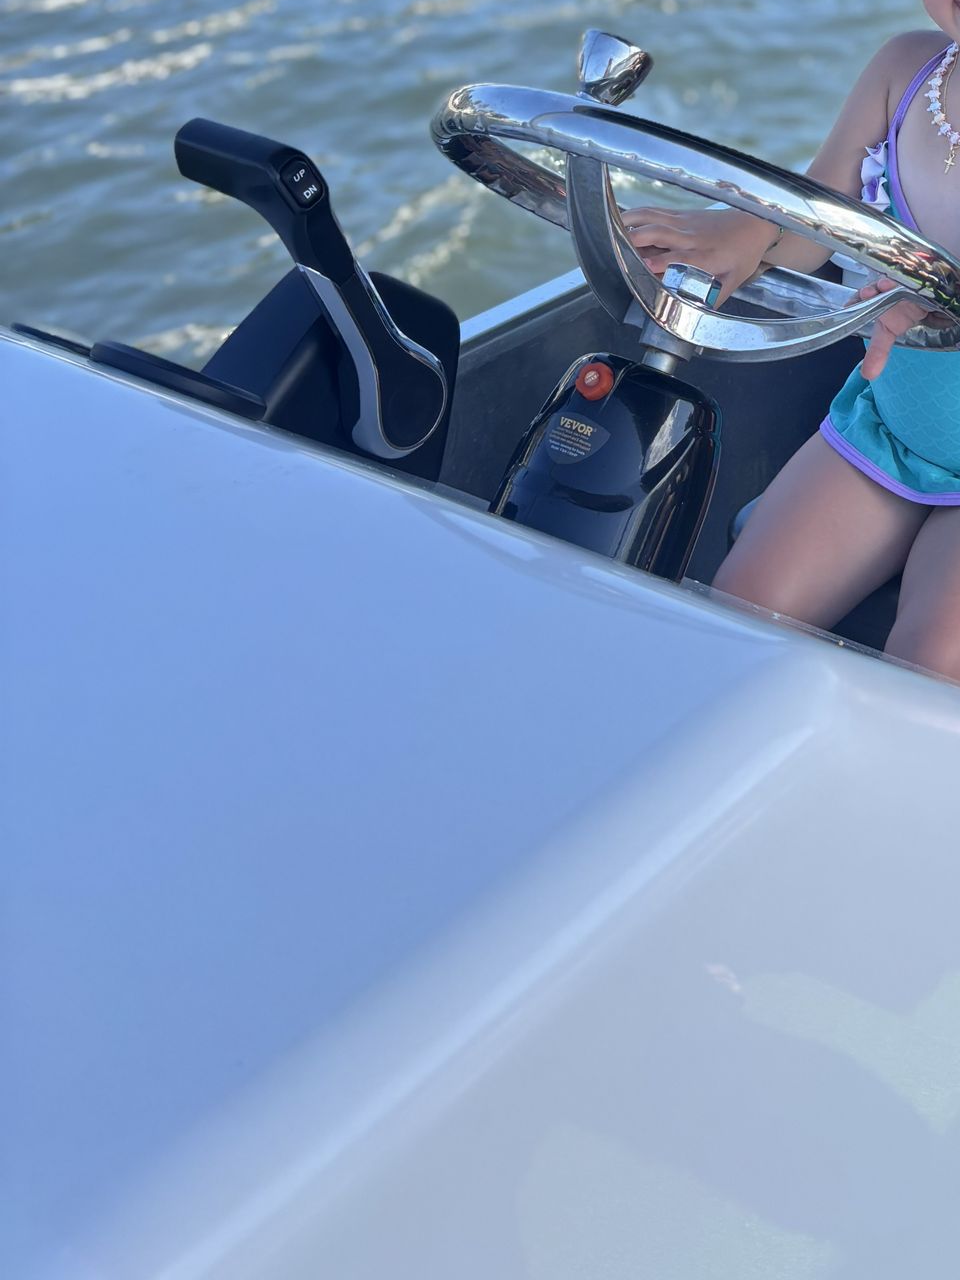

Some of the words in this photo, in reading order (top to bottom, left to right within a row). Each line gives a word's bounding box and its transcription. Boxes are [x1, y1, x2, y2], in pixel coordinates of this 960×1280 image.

[293, 168, 306, 183] UP
[303, 184, 318, 199] DN
[559, 416, 594, 437] VEVOR
